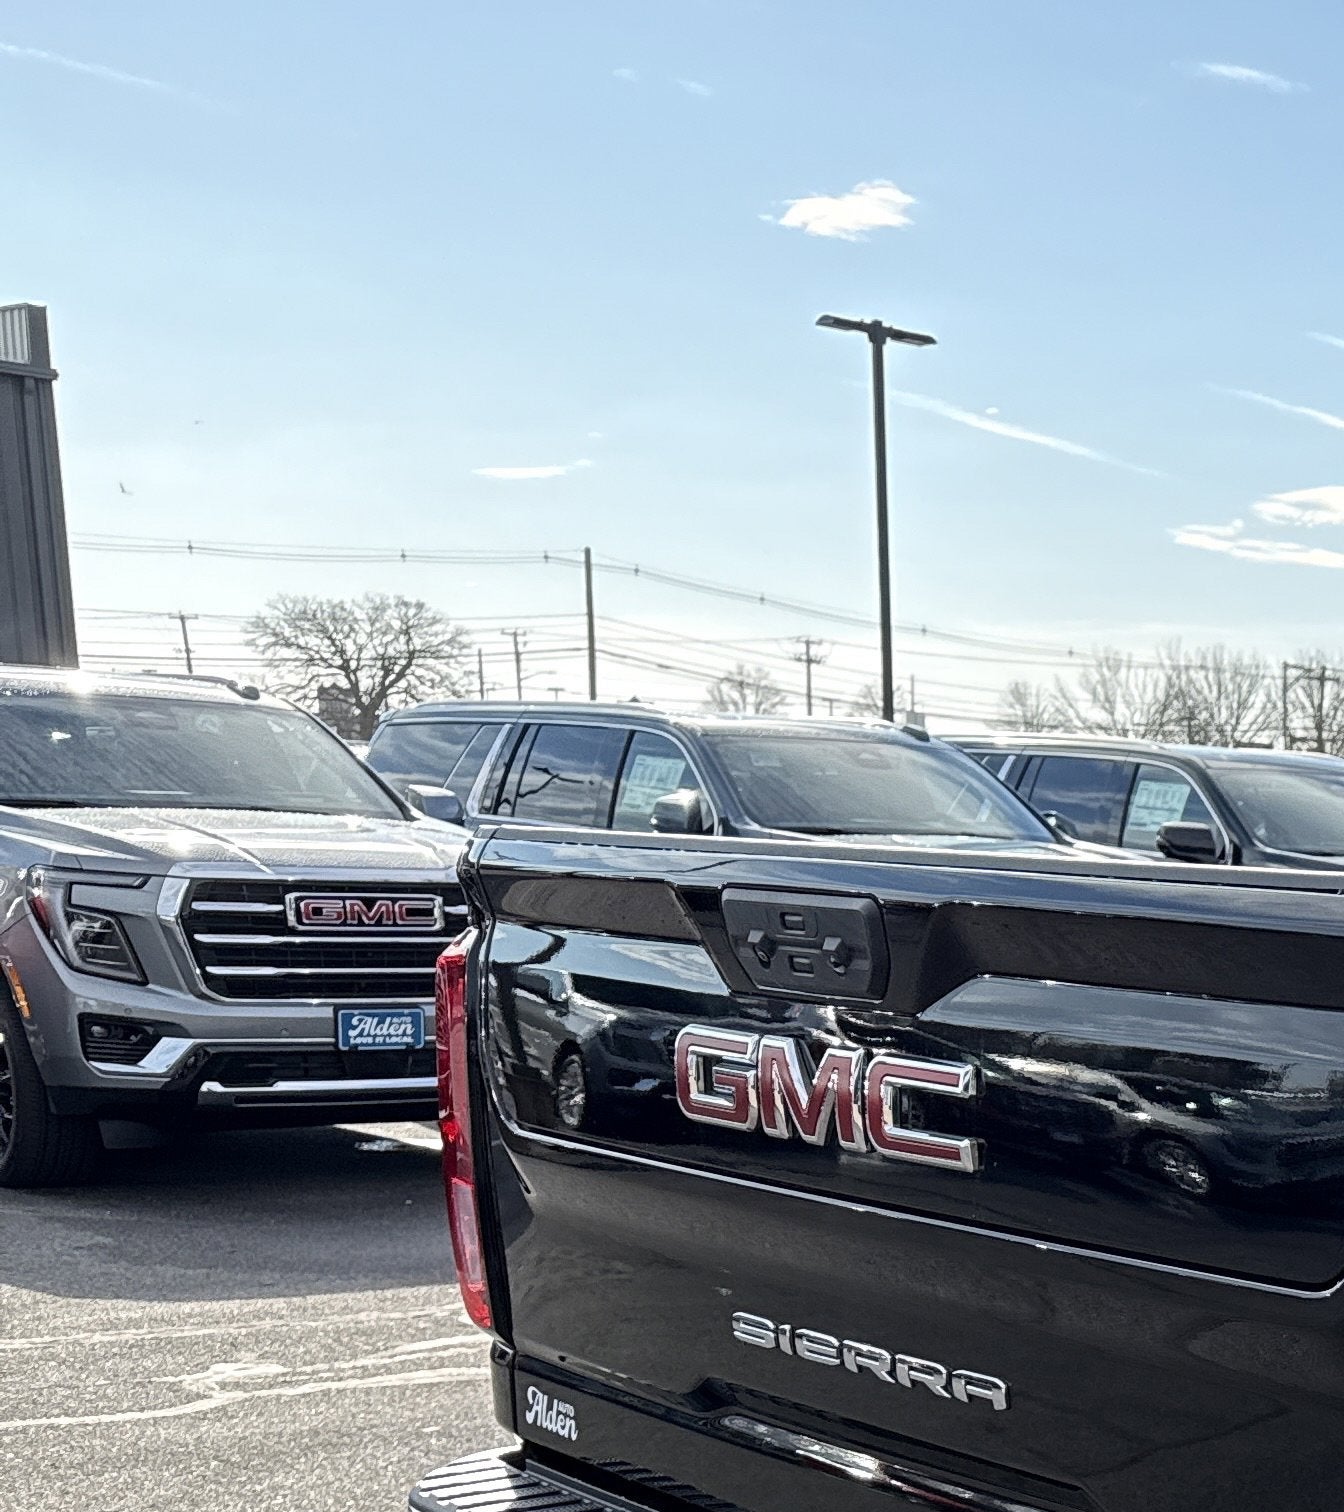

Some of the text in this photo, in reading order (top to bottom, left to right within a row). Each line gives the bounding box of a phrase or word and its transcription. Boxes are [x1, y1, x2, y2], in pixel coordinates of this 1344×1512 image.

[300, 899, 436, 925] GMC
[348, 1015, 416, 1037] Alden
[675, 1023, 978, 1173] GMC
[731, 1311, 1008, 1411] SIERRA
[525, 1385, 579, 1441] Alden
